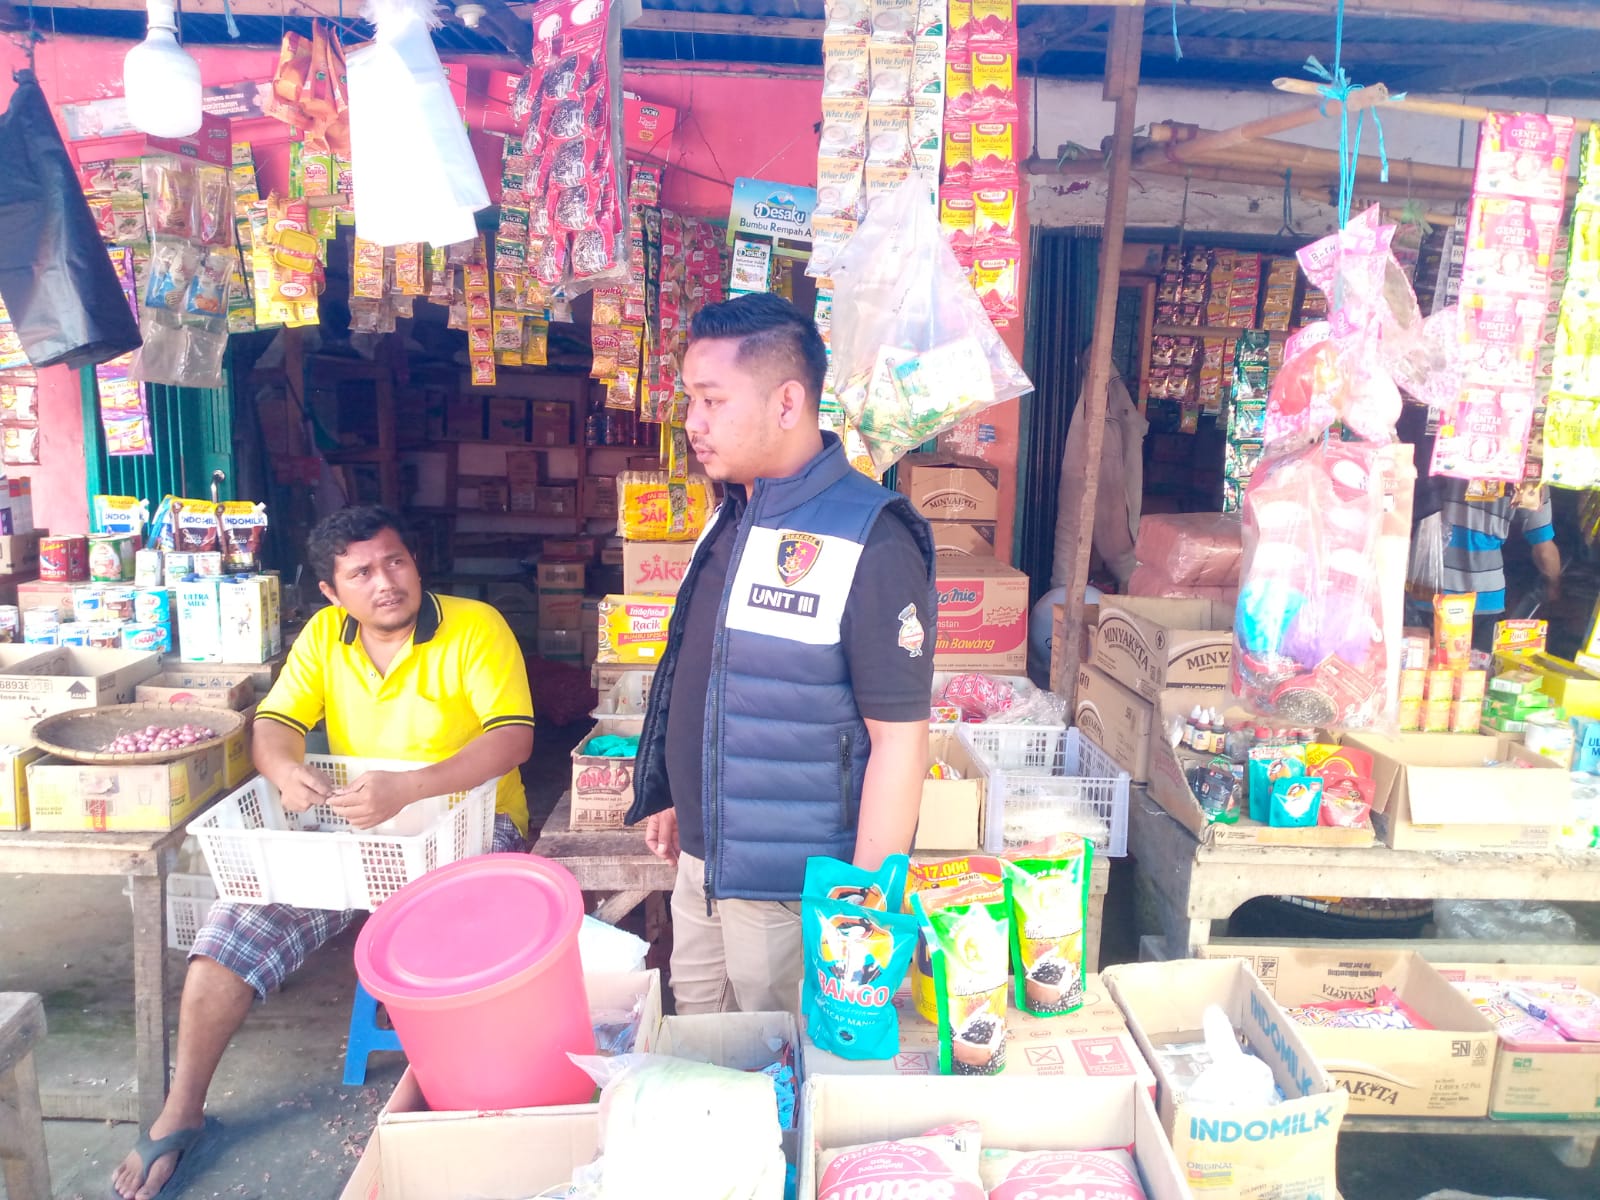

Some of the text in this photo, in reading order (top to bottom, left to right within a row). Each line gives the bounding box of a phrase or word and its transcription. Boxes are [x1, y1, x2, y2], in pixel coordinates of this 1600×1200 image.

[1511, 129, 1548, 140] GENTLE
[1518, 139, 1538, 149] GEN
[755, 202, 806, 226] Desaku
[739, 218, 768, 231] Bumbu
[769, 222, 804, 238] Rempah
[752, 587, 815, 613] UNIT III
[951, 588, 976, 602] Mie
[629, 606, 667, 618] Indofood
[632, 619, 661, 632] Racik
[936, 619, 960, 629] nstan
[951, 637, 995, 651] Bawang
[1104, 626, 1149, 673] MINYAKITA
[818, 970, 889, 1008] BANGO
[1321, 983, 1380, 1001] INYAKITA
[1250, 989, 1313, 1097] INDOMILK
[1451, 1040, 1471, 1057] SNI
[1189, 1105, 1334, 1143] INDOMILK
